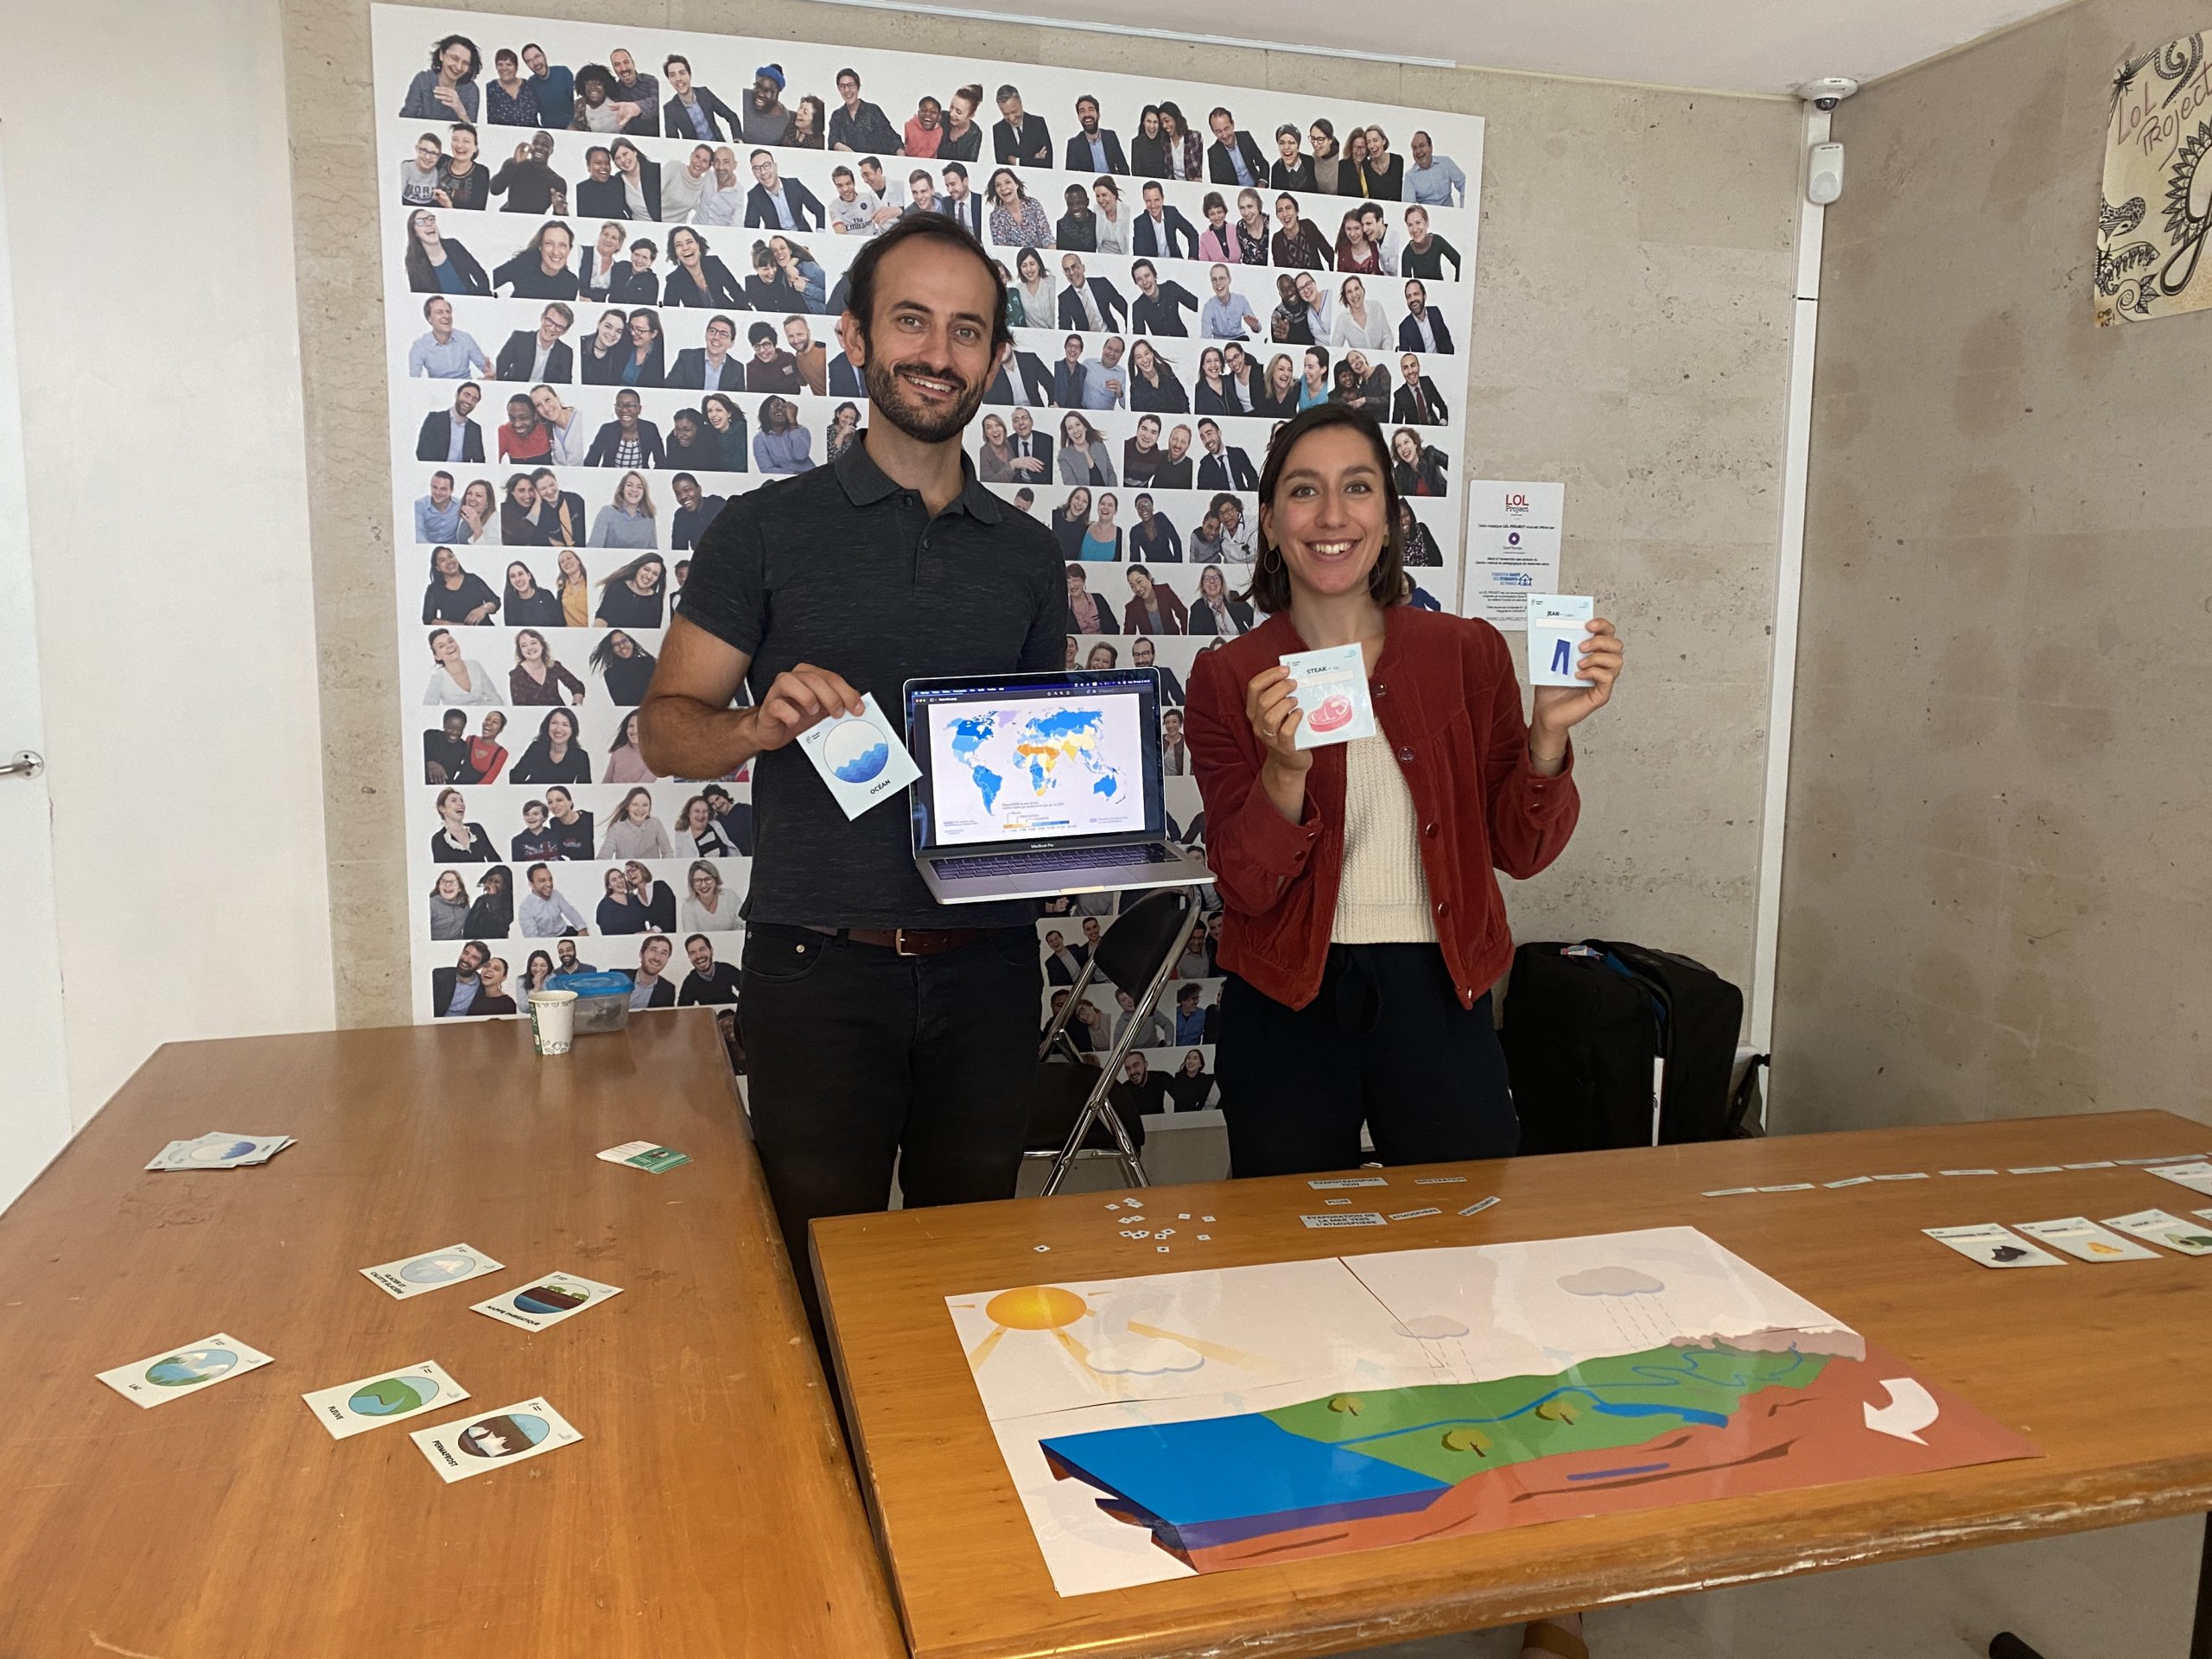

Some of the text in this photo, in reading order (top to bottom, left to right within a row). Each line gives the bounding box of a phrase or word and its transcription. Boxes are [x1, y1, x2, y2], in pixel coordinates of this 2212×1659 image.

[1505, 494, 1529, 506] LOL
[870, 779, 891, 795] OCÉAN
[486, 1305, 542, 1325] NAPPE PHRÉATIQUE
[327, 1405, 344, 1421] FLEUVE
[432, 1440, 459, 1467] PERMAFROST
